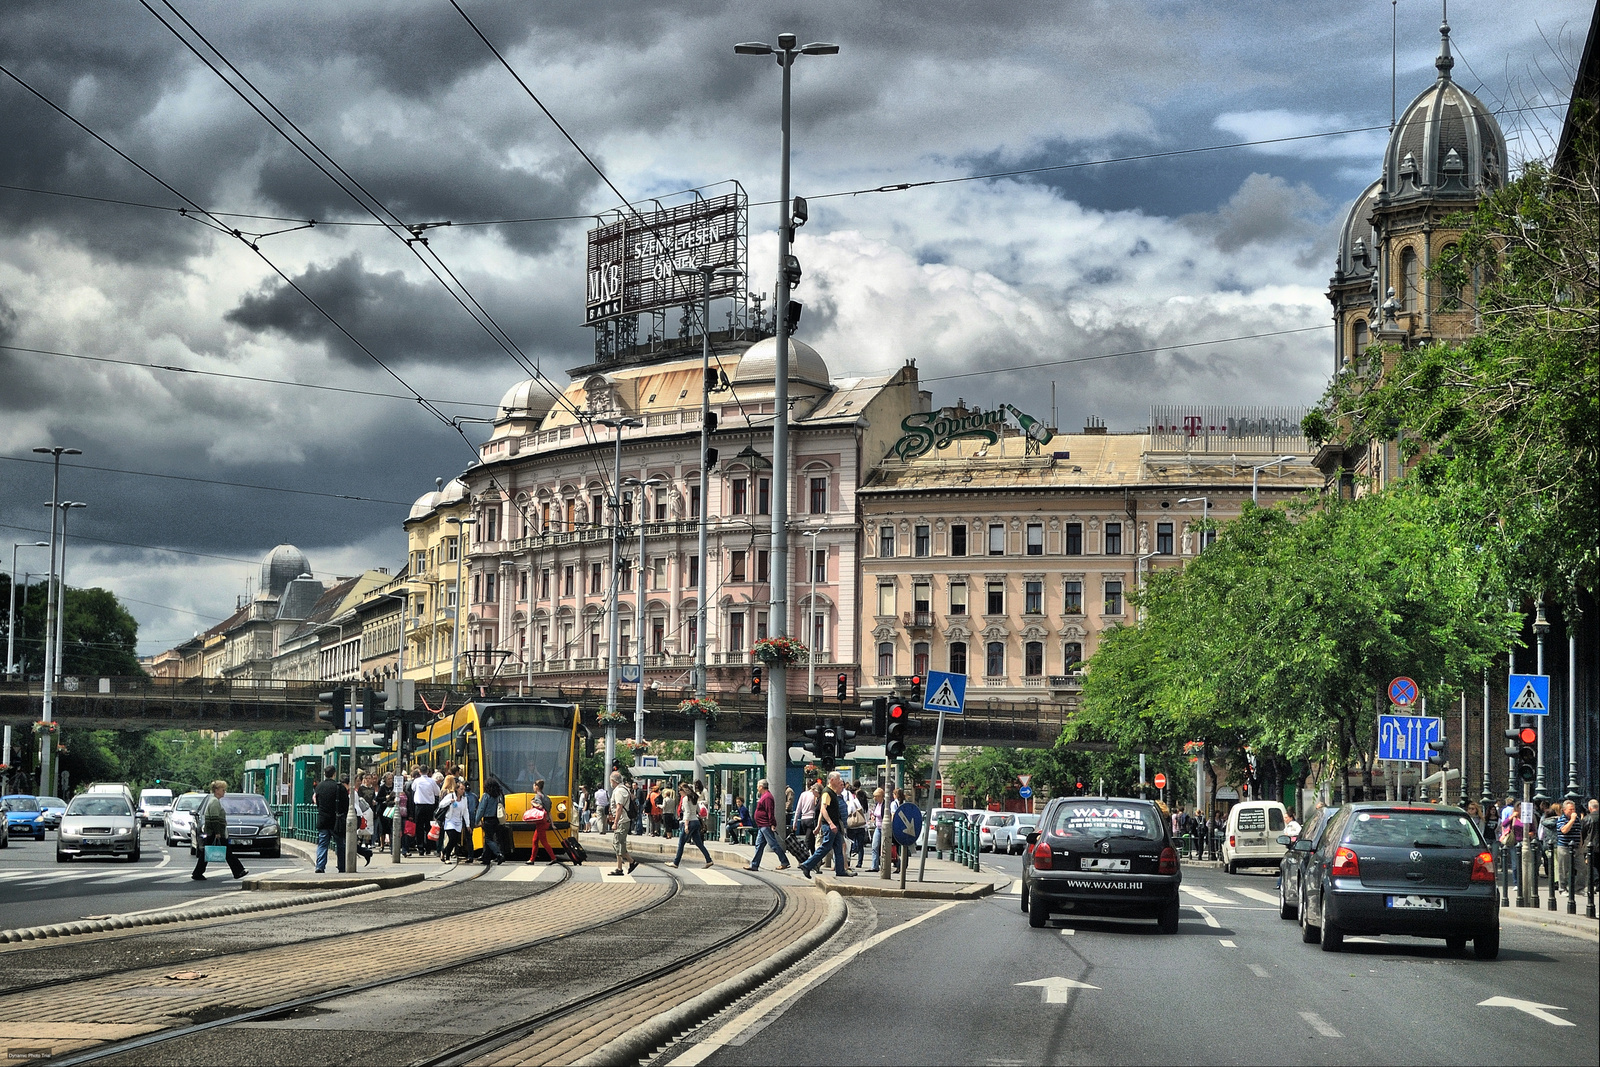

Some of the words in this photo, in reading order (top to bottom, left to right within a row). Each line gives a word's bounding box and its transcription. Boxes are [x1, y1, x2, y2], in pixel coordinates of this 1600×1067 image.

[634, 225, 719, 259] SZEMÉLYESEN
[588, 262, 618, 302] MKB
[590, 302, 618, 319] BANK
[894, 403, 1007, 462] Soproni
[1184, 416, 1201, 437] T
[1073, 808, 1140, 819] WASABI
[1067, 880, 1143, 890] WWW.WASABI.HU
